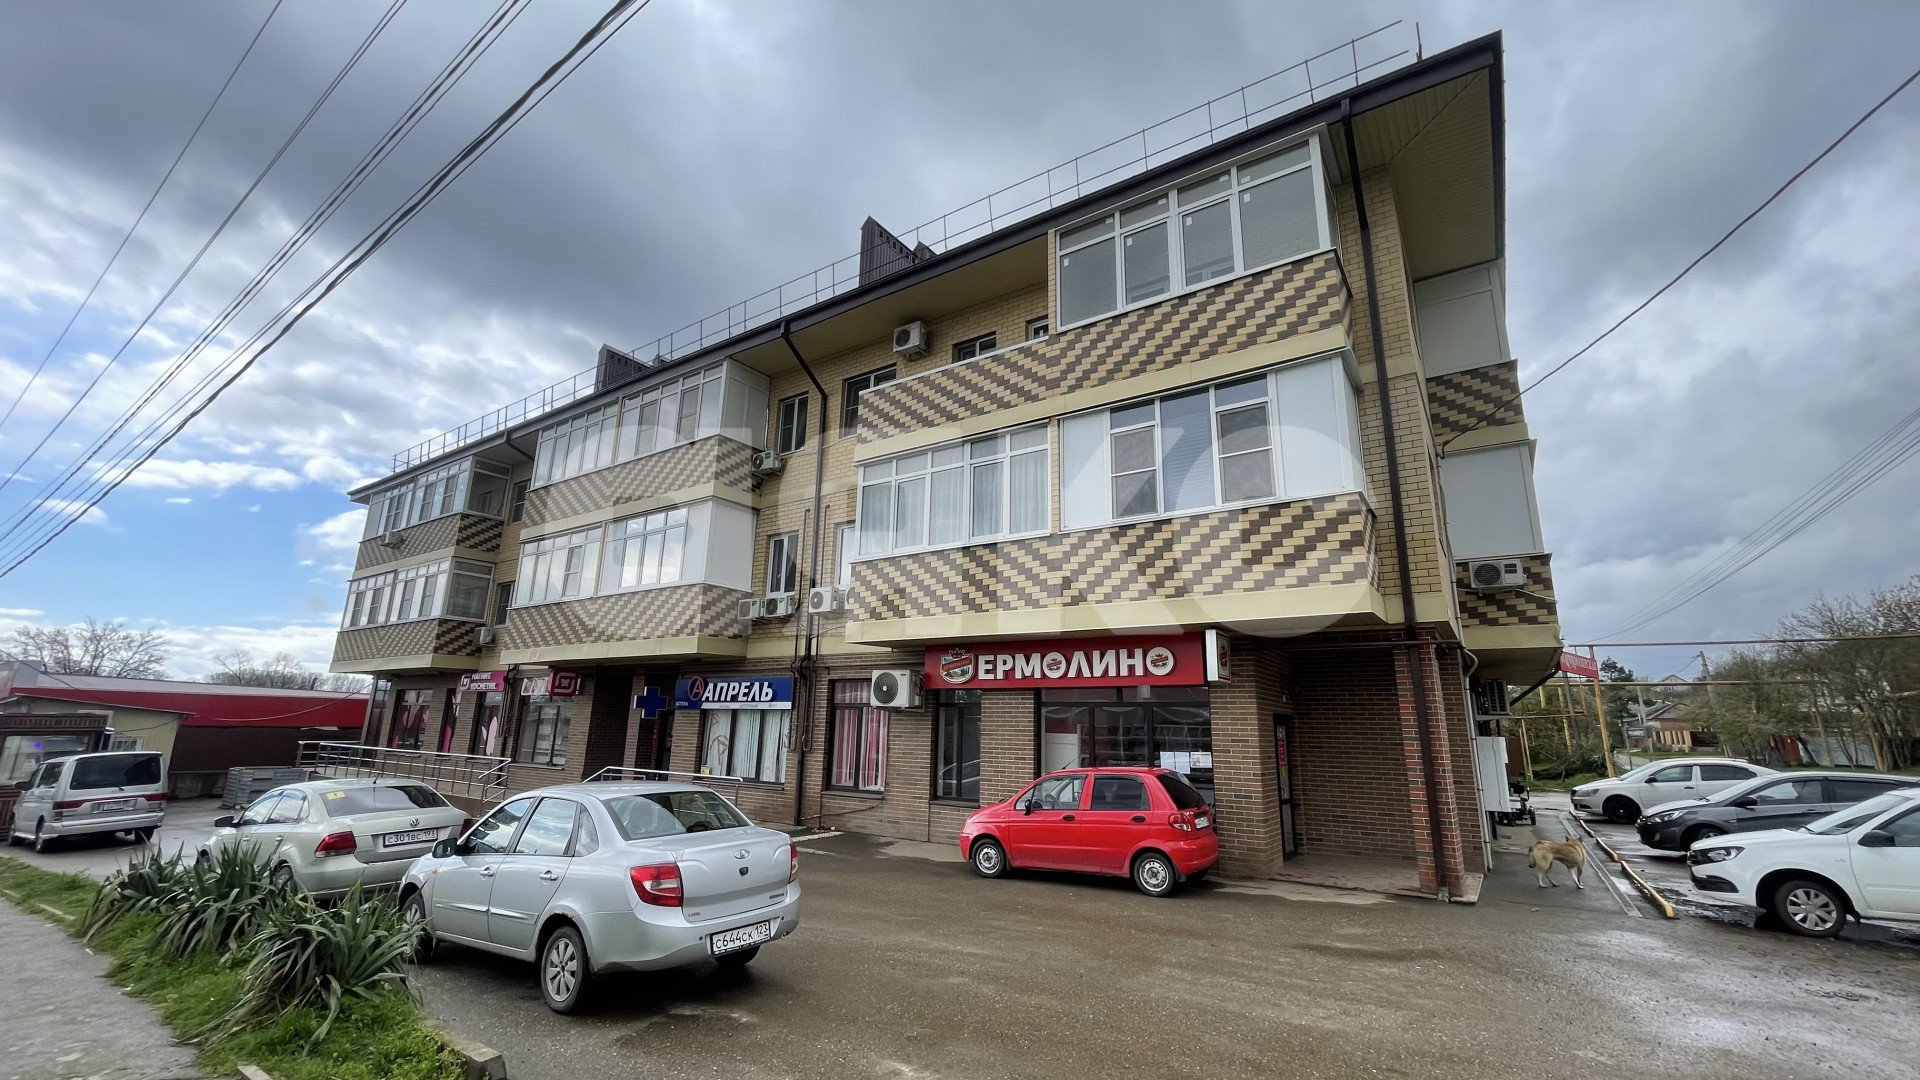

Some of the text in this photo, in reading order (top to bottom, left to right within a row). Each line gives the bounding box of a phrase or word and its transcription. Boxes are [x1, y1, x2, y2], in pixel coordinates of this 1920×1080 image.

[977, 647, 1174, 680] ЕРМОЛИНО
[702, 681, 773, 702] АПРЕЛЬ
[715, 931, 754, 949] С644СК
[755, 923, 768, 935] 123
